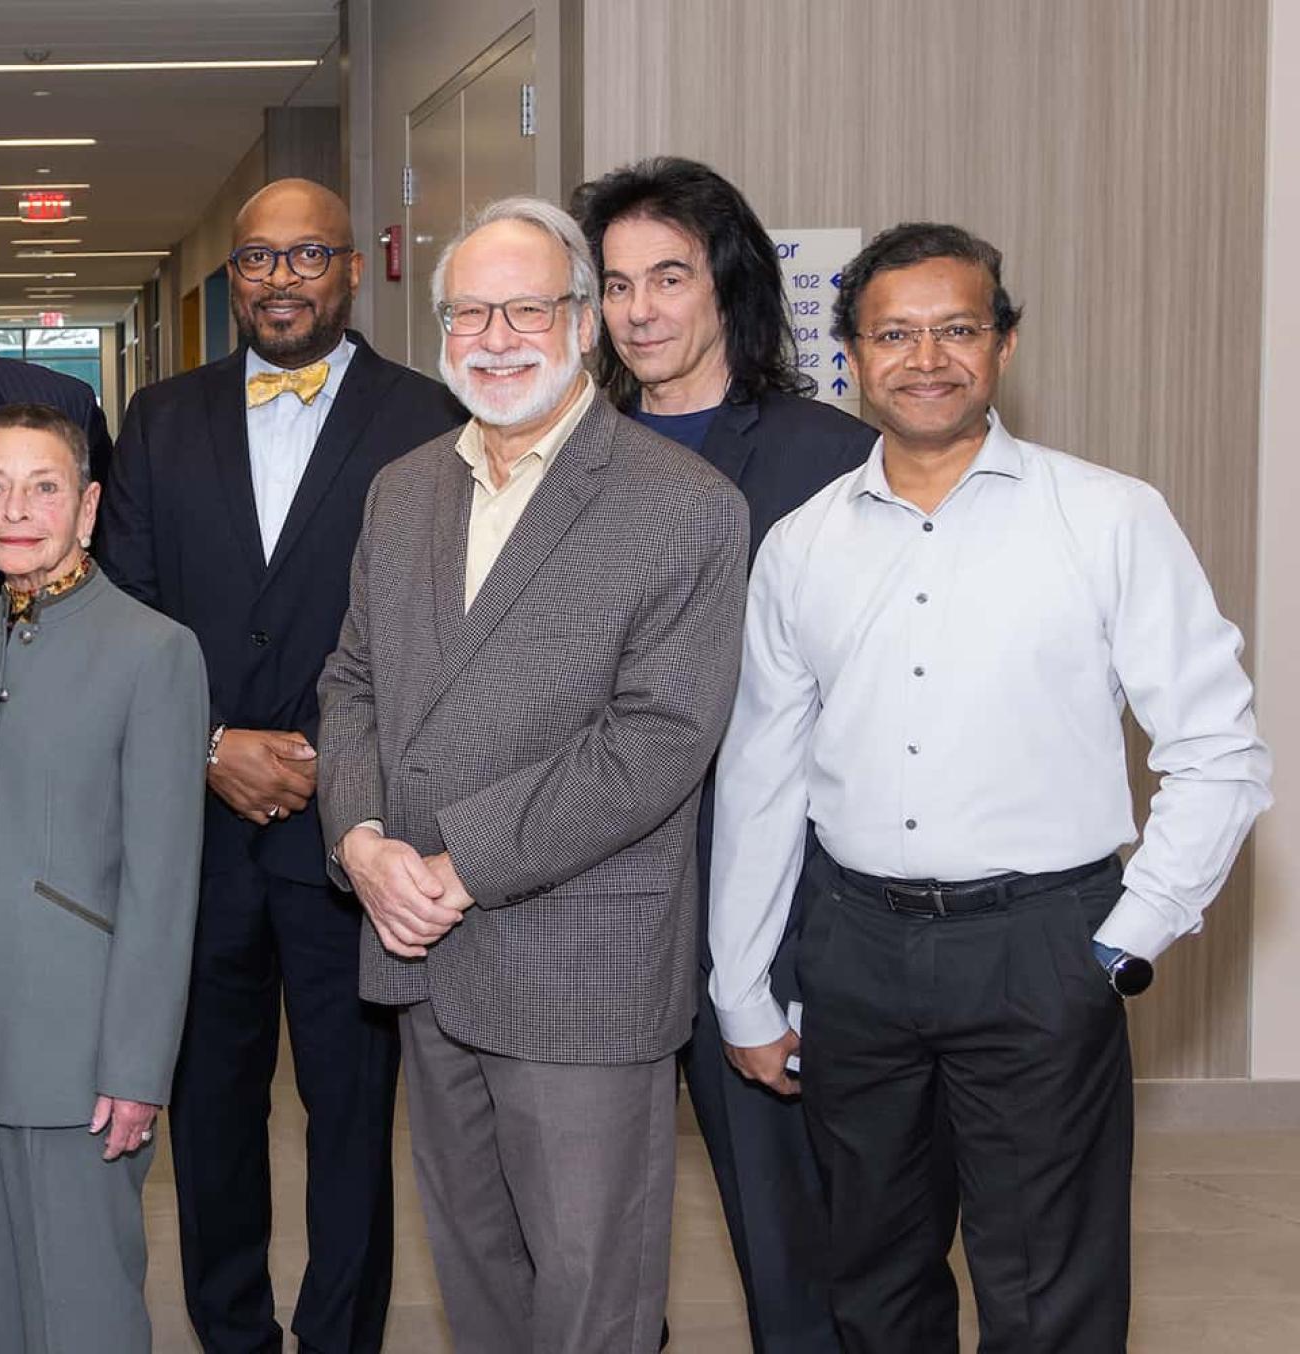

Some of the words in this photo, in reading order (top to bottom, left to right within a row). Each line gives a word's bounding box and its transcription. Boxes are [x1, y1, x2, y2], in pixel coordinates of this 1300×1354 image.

[792, 274, 820, 289] 102
[791, 301, 820, 315] 132
[794, 327, 819, 342] 104
